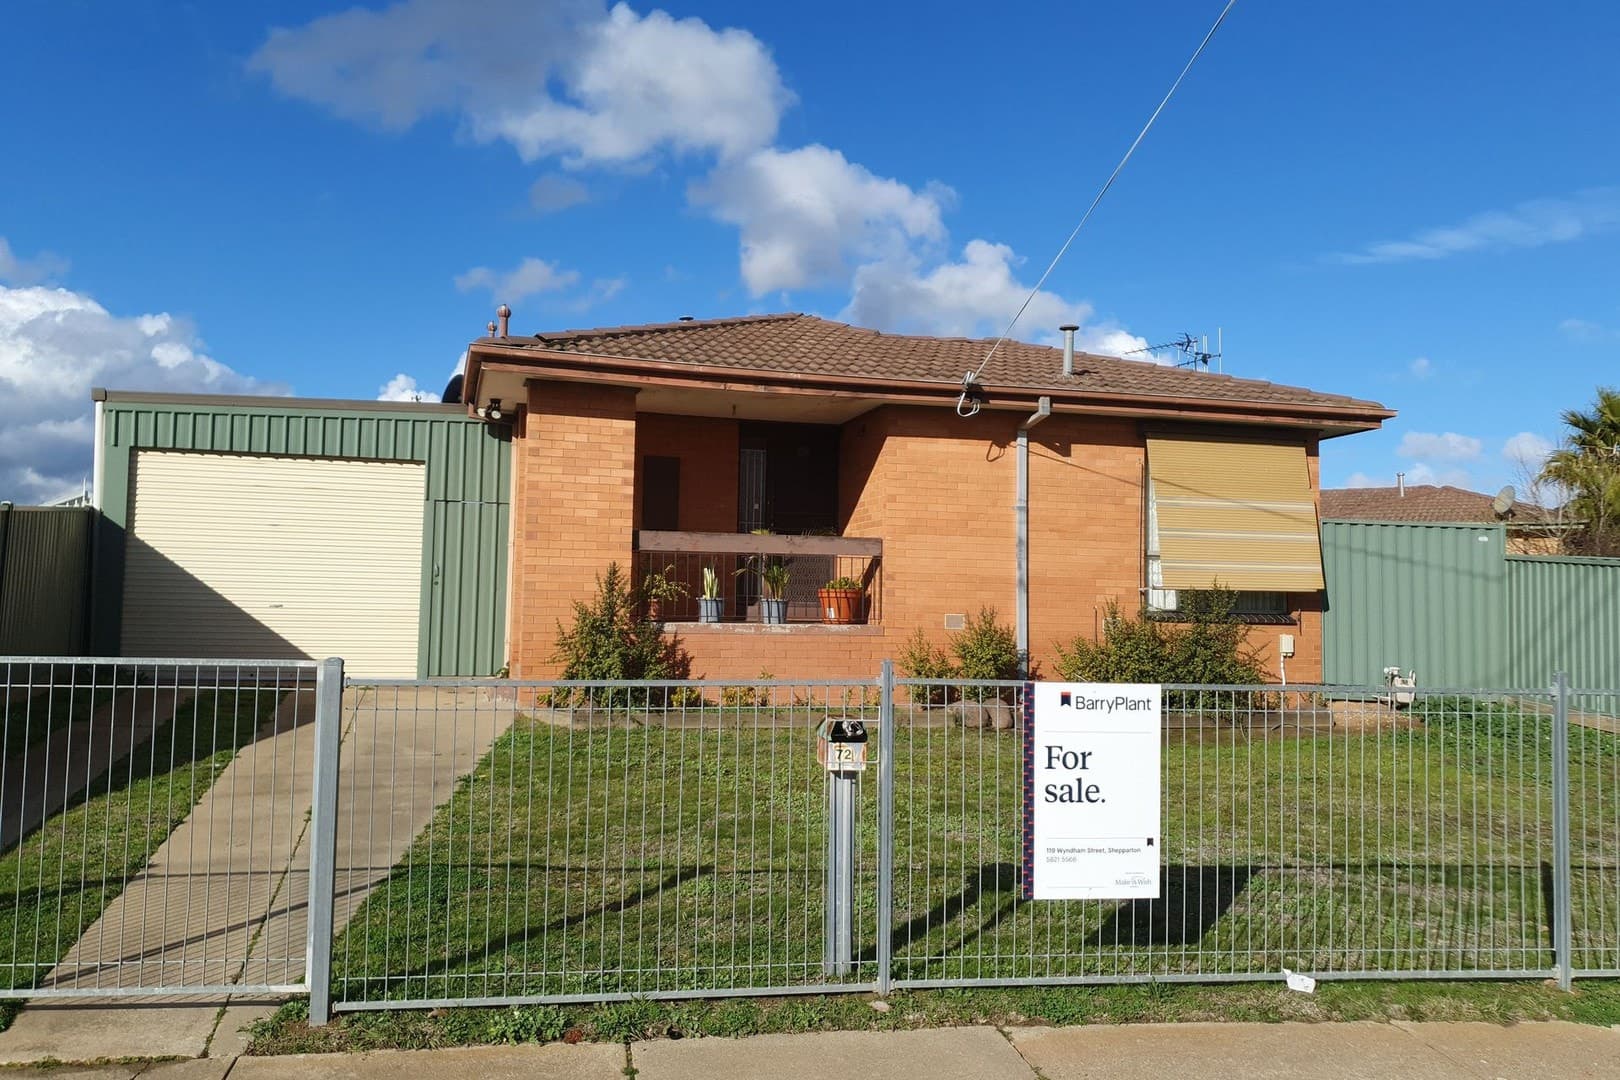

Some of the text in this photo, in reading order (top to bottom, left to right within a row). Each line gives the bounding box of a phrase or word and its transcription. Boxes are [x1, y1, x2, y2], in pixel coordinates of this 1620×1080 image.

[1075, 695, 1152, 714] BarryPlant
[836, 749, 851, 760] 72
[1044, 745, 1093, 770] For
[1044, 777, 1106, 803] sale.
[1057, 847, 1086, 856] Wyndham
[1087, 847, 1106, 855] Street,
[1108, 847, 1141, 856] Shepparton
